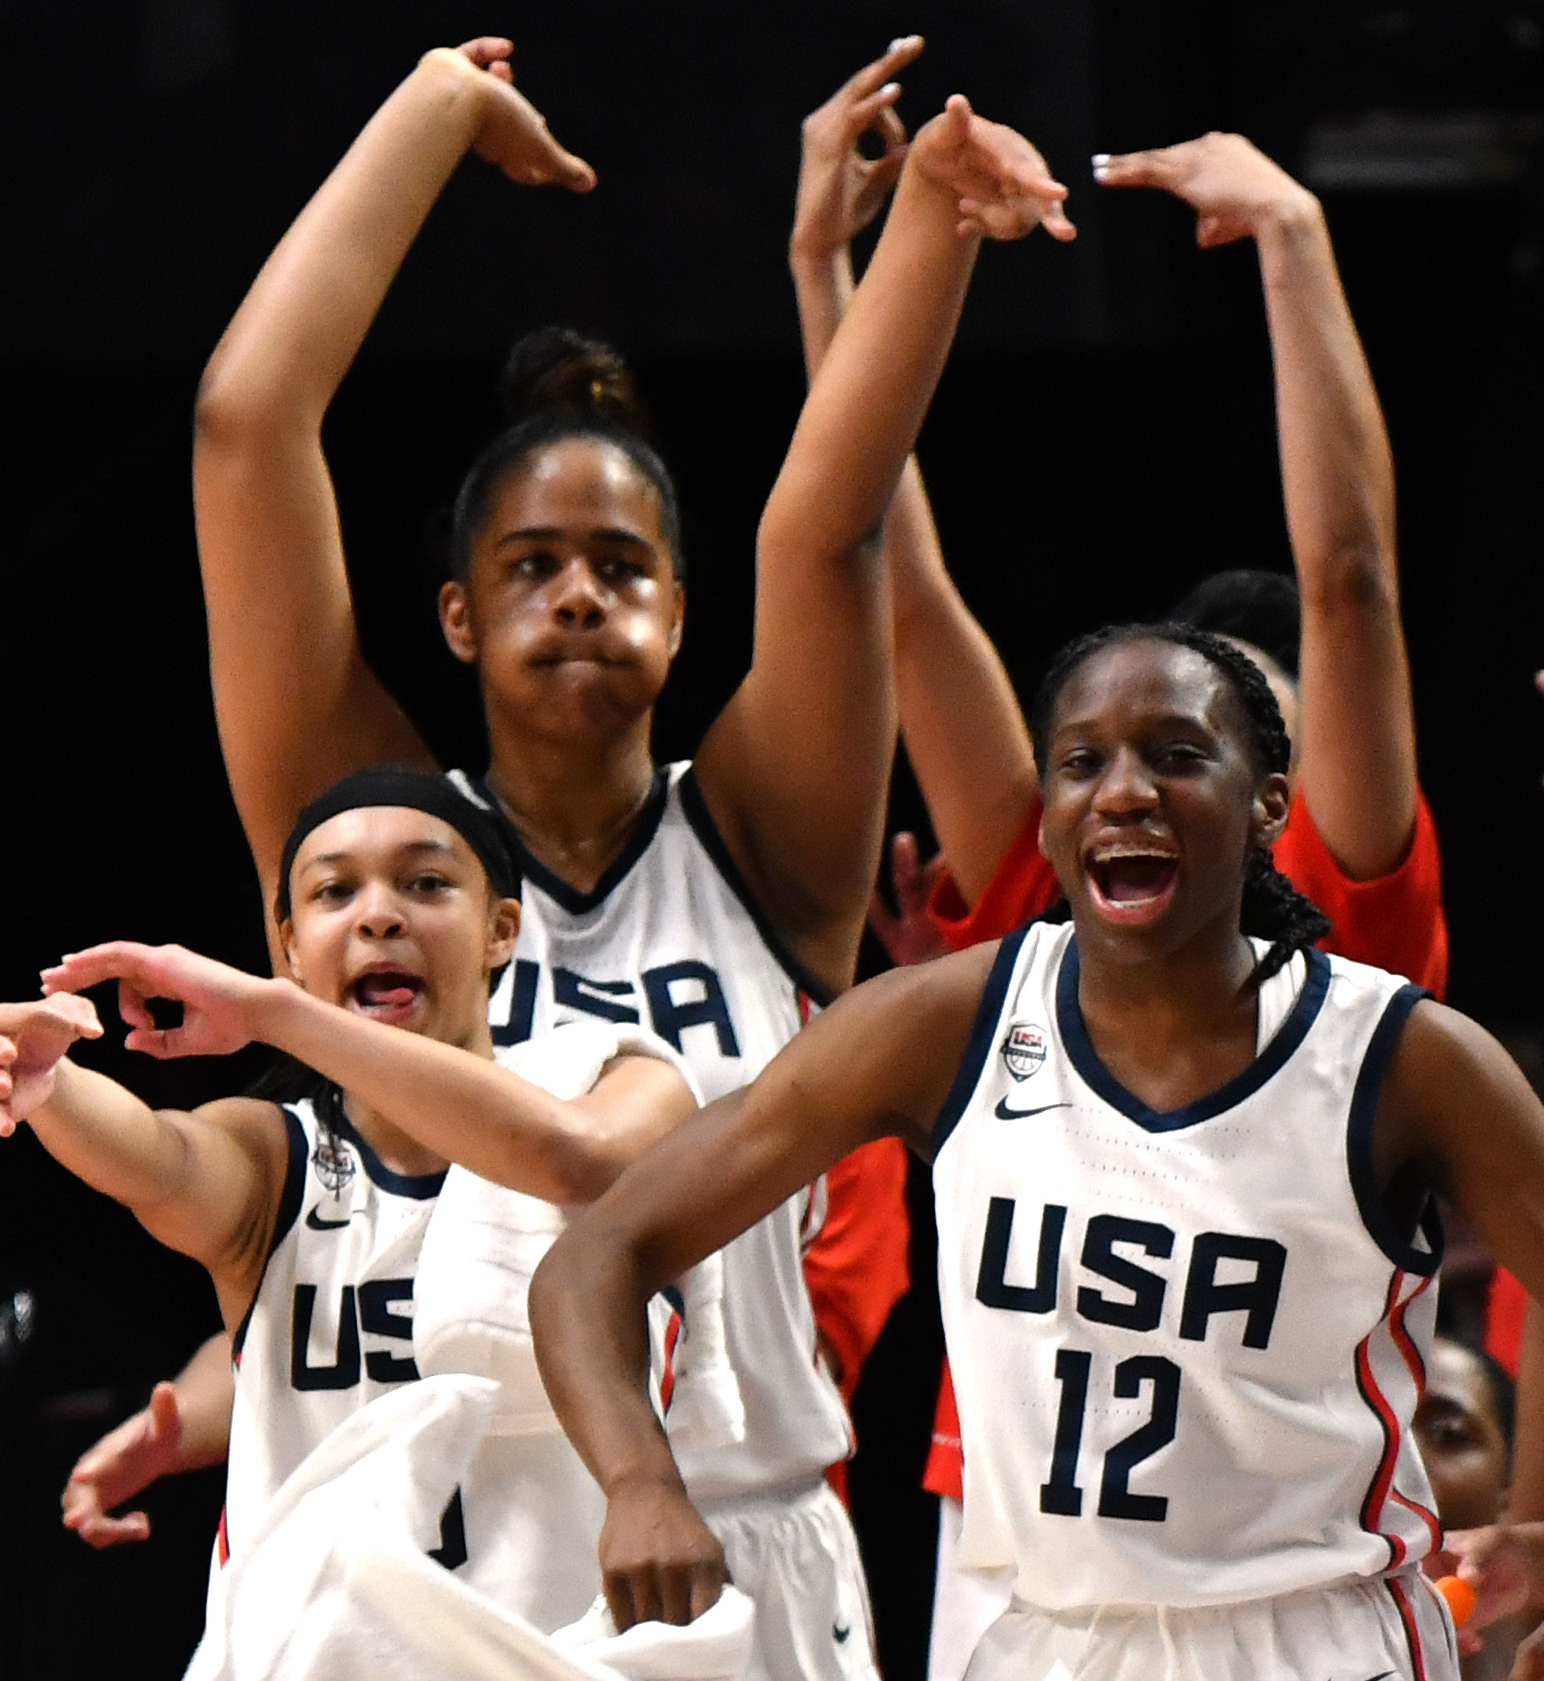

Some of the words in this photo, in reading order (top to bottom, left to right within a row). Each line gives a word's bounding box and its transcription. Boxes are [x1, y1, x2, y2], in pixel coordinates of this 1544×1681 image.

[490, 958, 742, 1058] USA
[975, 1196, 1288, 1350] USA
[1039, 1348, 1183, 1522] 12
